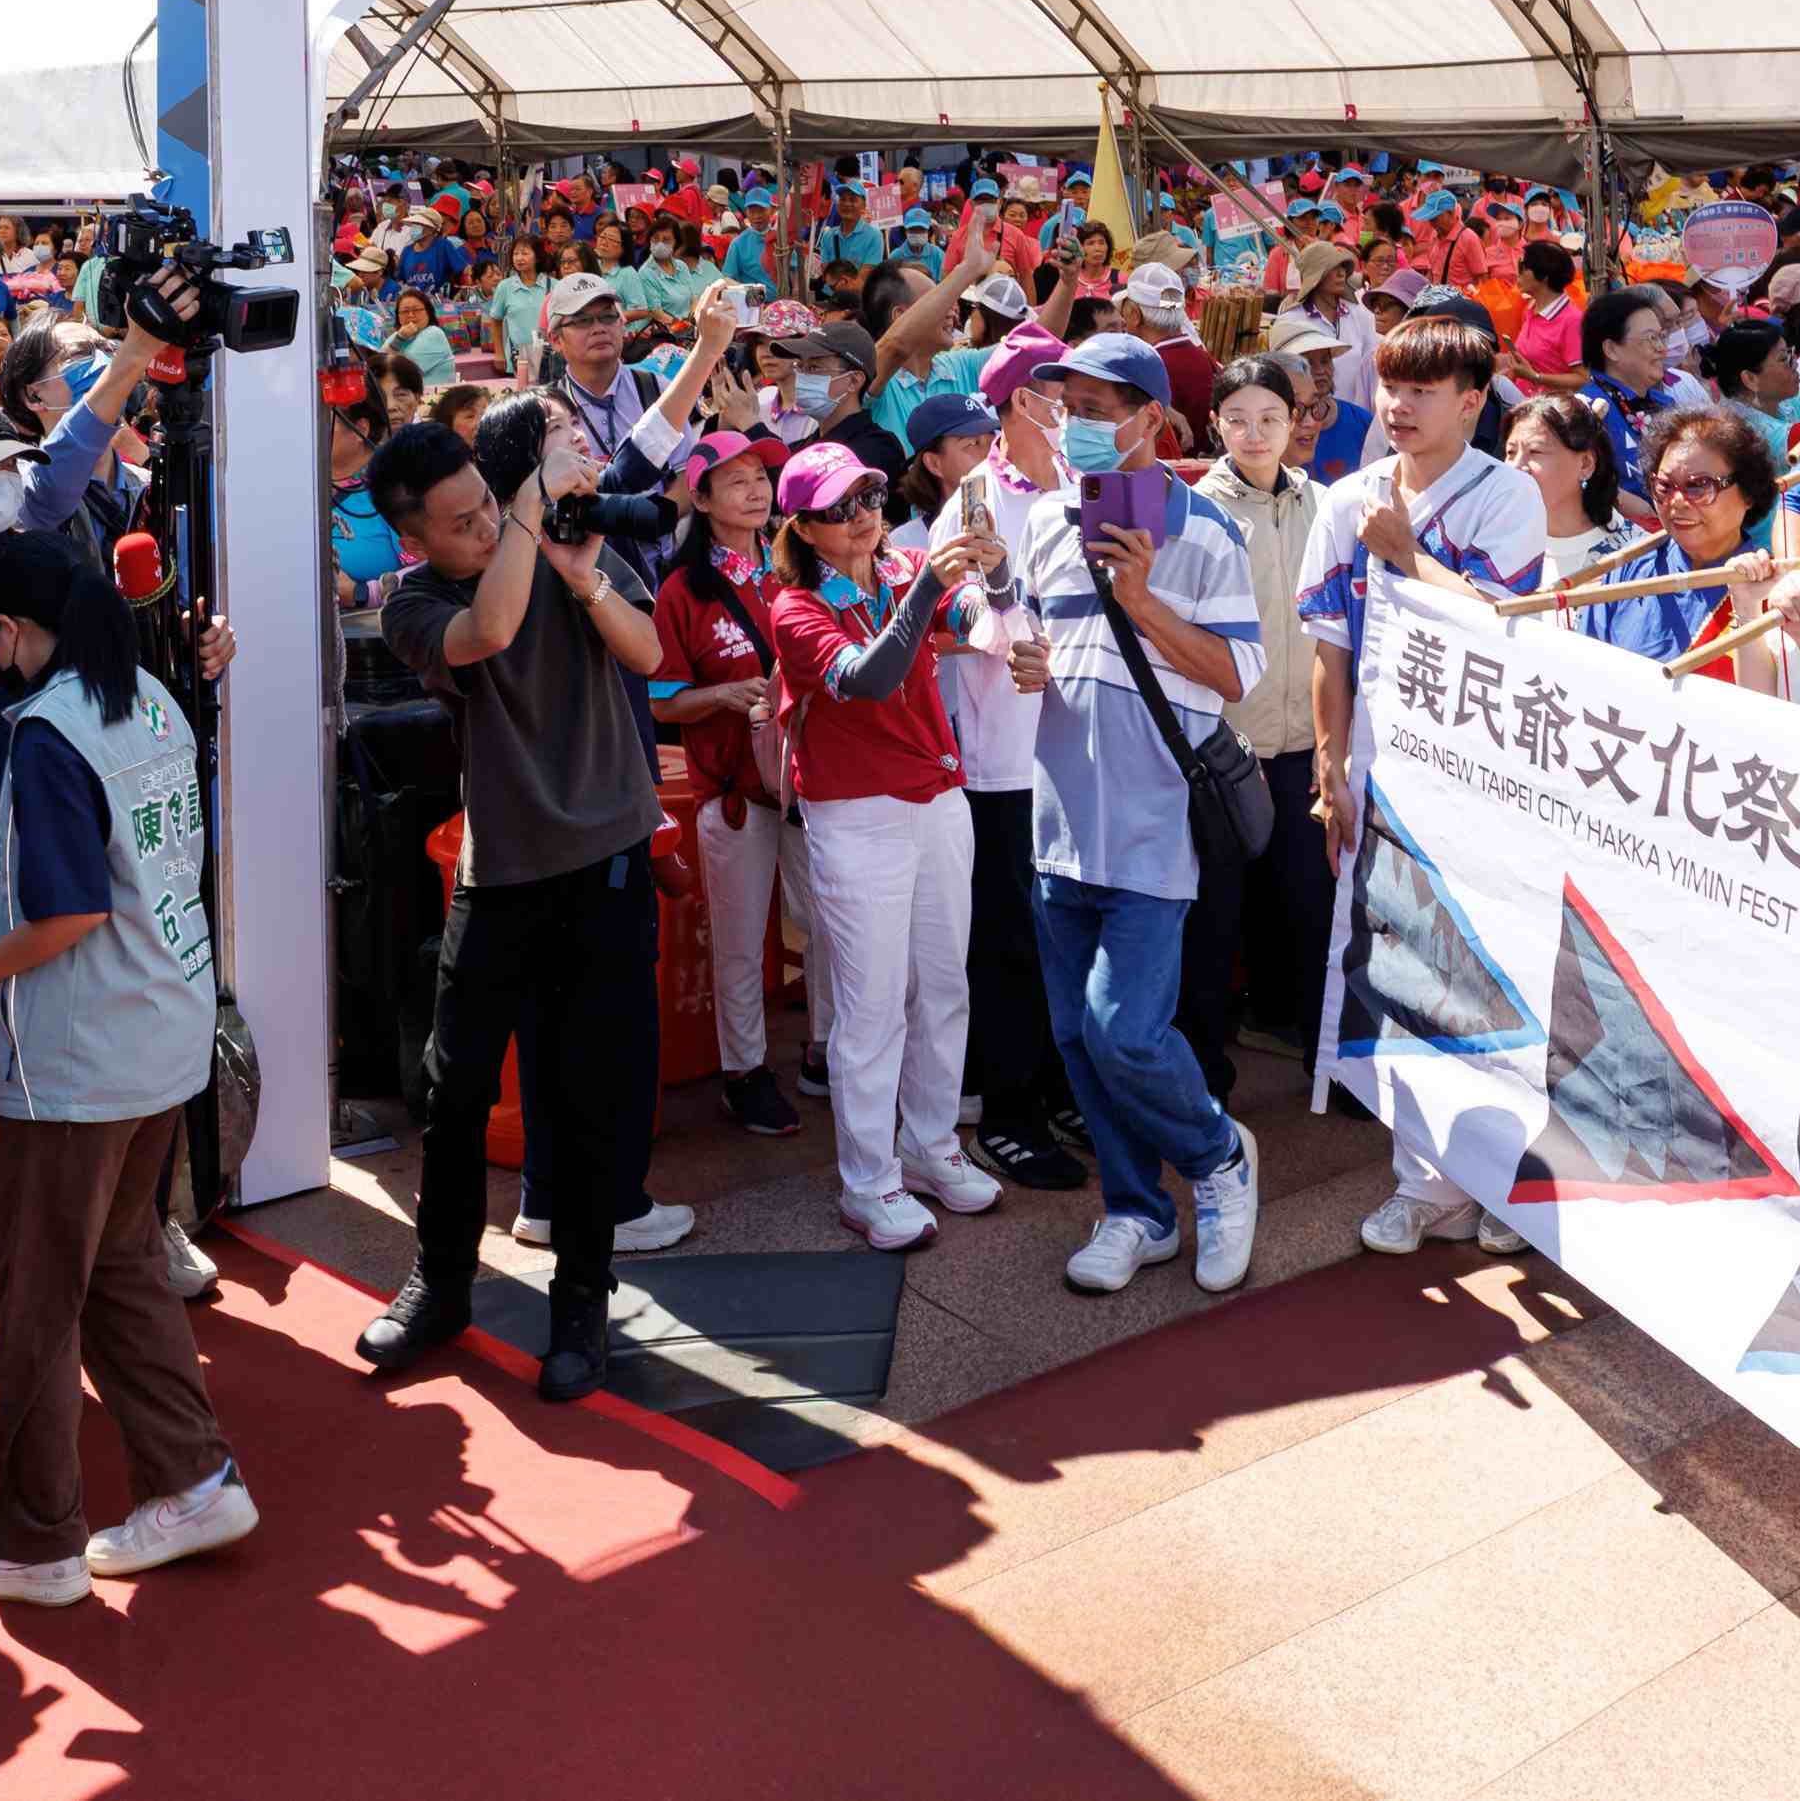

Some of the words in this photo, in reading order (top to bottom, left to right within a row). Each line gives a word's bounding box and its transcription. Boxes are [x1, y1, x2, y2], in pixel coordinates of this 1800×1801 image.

[1390, 724, 1429, 763] 2026
[1432, 743, 1475, 785] NEW
[1478, 764, 1532, 811] TAIPEI
[1538, 791, 1583, 832] CITY
[1586, 818, 1661, 872] HAKKA
[1666, 850, 1733, 908] YIMIN
[1738, 884, 1798, 935] FEST
